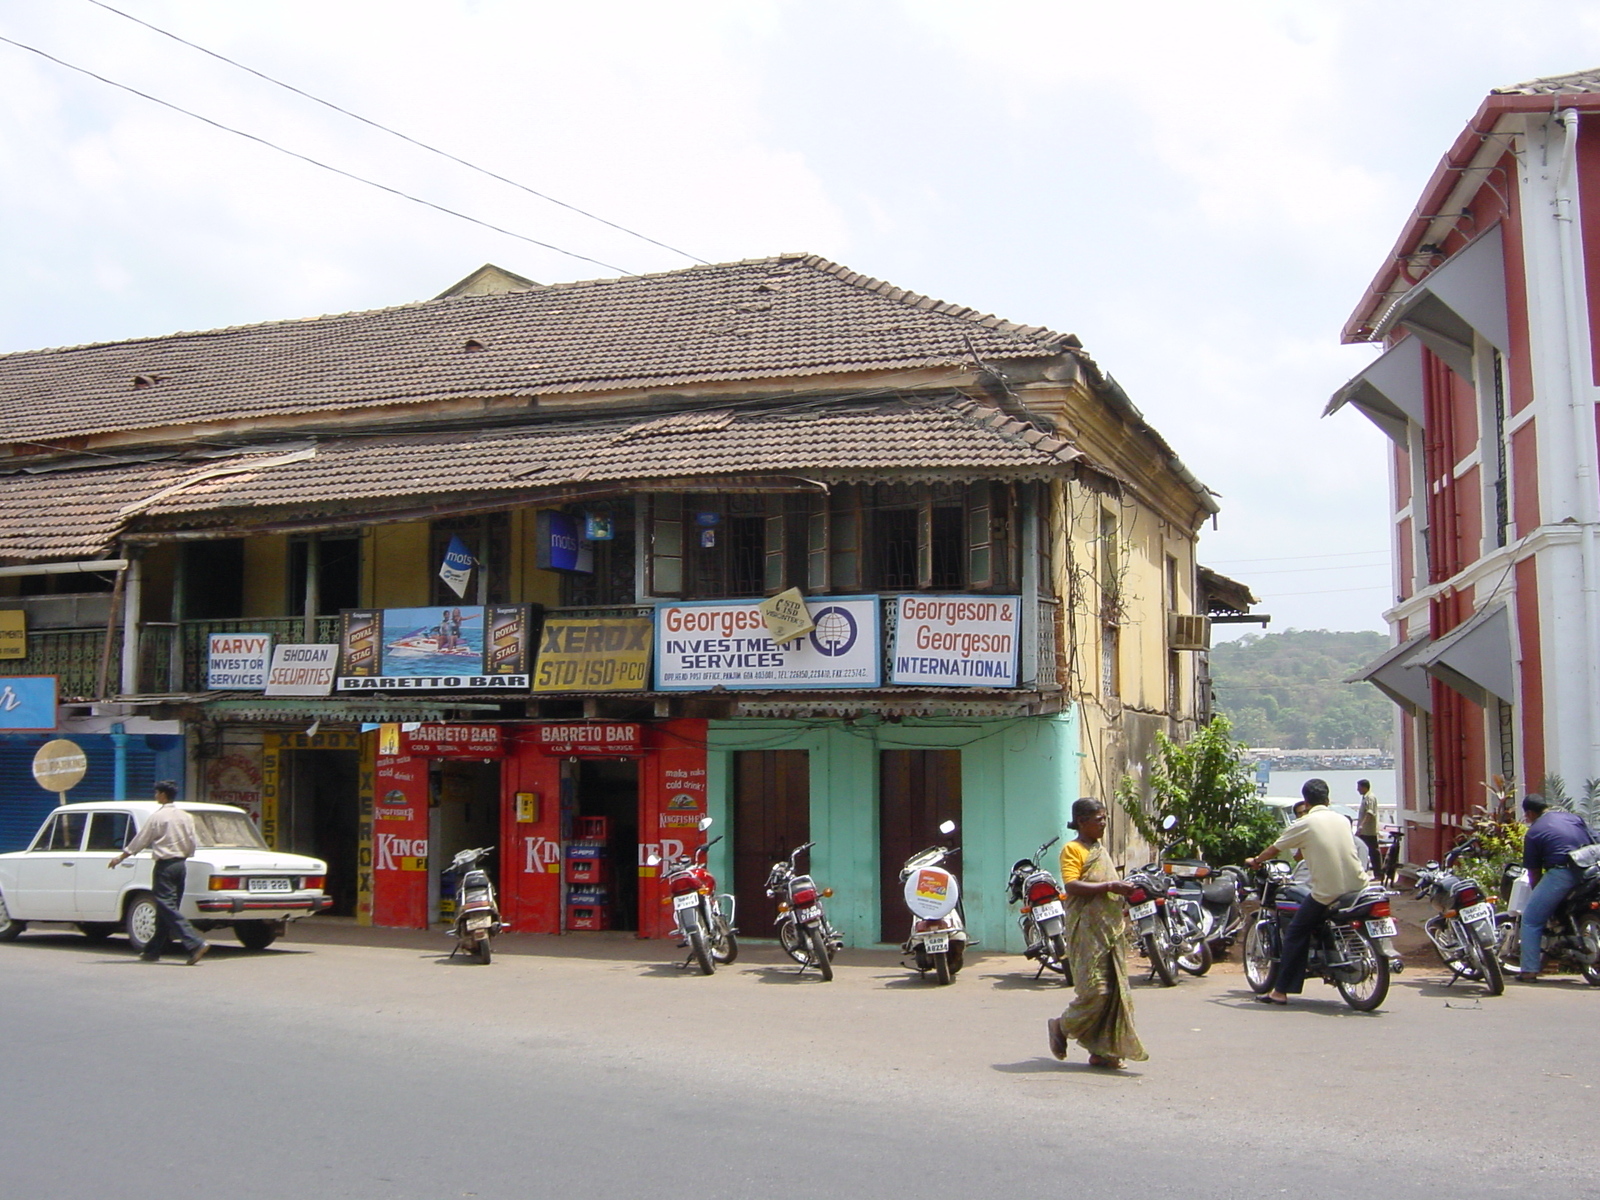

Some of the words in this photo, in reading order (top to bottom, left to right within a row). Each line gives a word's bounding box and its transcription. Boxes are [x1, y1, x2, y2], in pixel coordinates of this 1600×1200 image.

[783, 600, 801, 610] STD
[783, 607, 799, 617] ISD
[902, 597, 998, 626] Georgeson
[1000, 602, 1013, 622] &
[351, 628, 373, 642] ROYAL
[495, 623, 519, 639] ROYAL
[211, 639, 267, 654] KARVY
[543, 625, 650, 654] XEROX
[666, 637, 806, 654] INVESTMENT
[916, 625, 1011, 658] Georgeson
[283, 649, 329, 662] SHODAN
[351, 648, 371, 662] STAG
[496, 644, 517, 660] STAG
[211, 658, 264, 670] INVESTOR
[681, 652, 784, 669] SERVICES
[897, 657, 1011, 679] INTERNATIONAL
[210, 674, 263, 685] SERVICES
[269, 667, 333, 685] SECURITIES
[343, 676, 466, 688] BARETTO
[469, 675, 526, 687] BAR
[279, 732, 359, 748] XEROX
[409, 727, 468, 741] BARRETO
[471, 727, 498, 742] BAR
[541, 726, 601, 742] BARRETO
[606, 726, 635, 741] BAR
[666, 780, 682, 789] cold
[376, 833, 428, 871] KING
